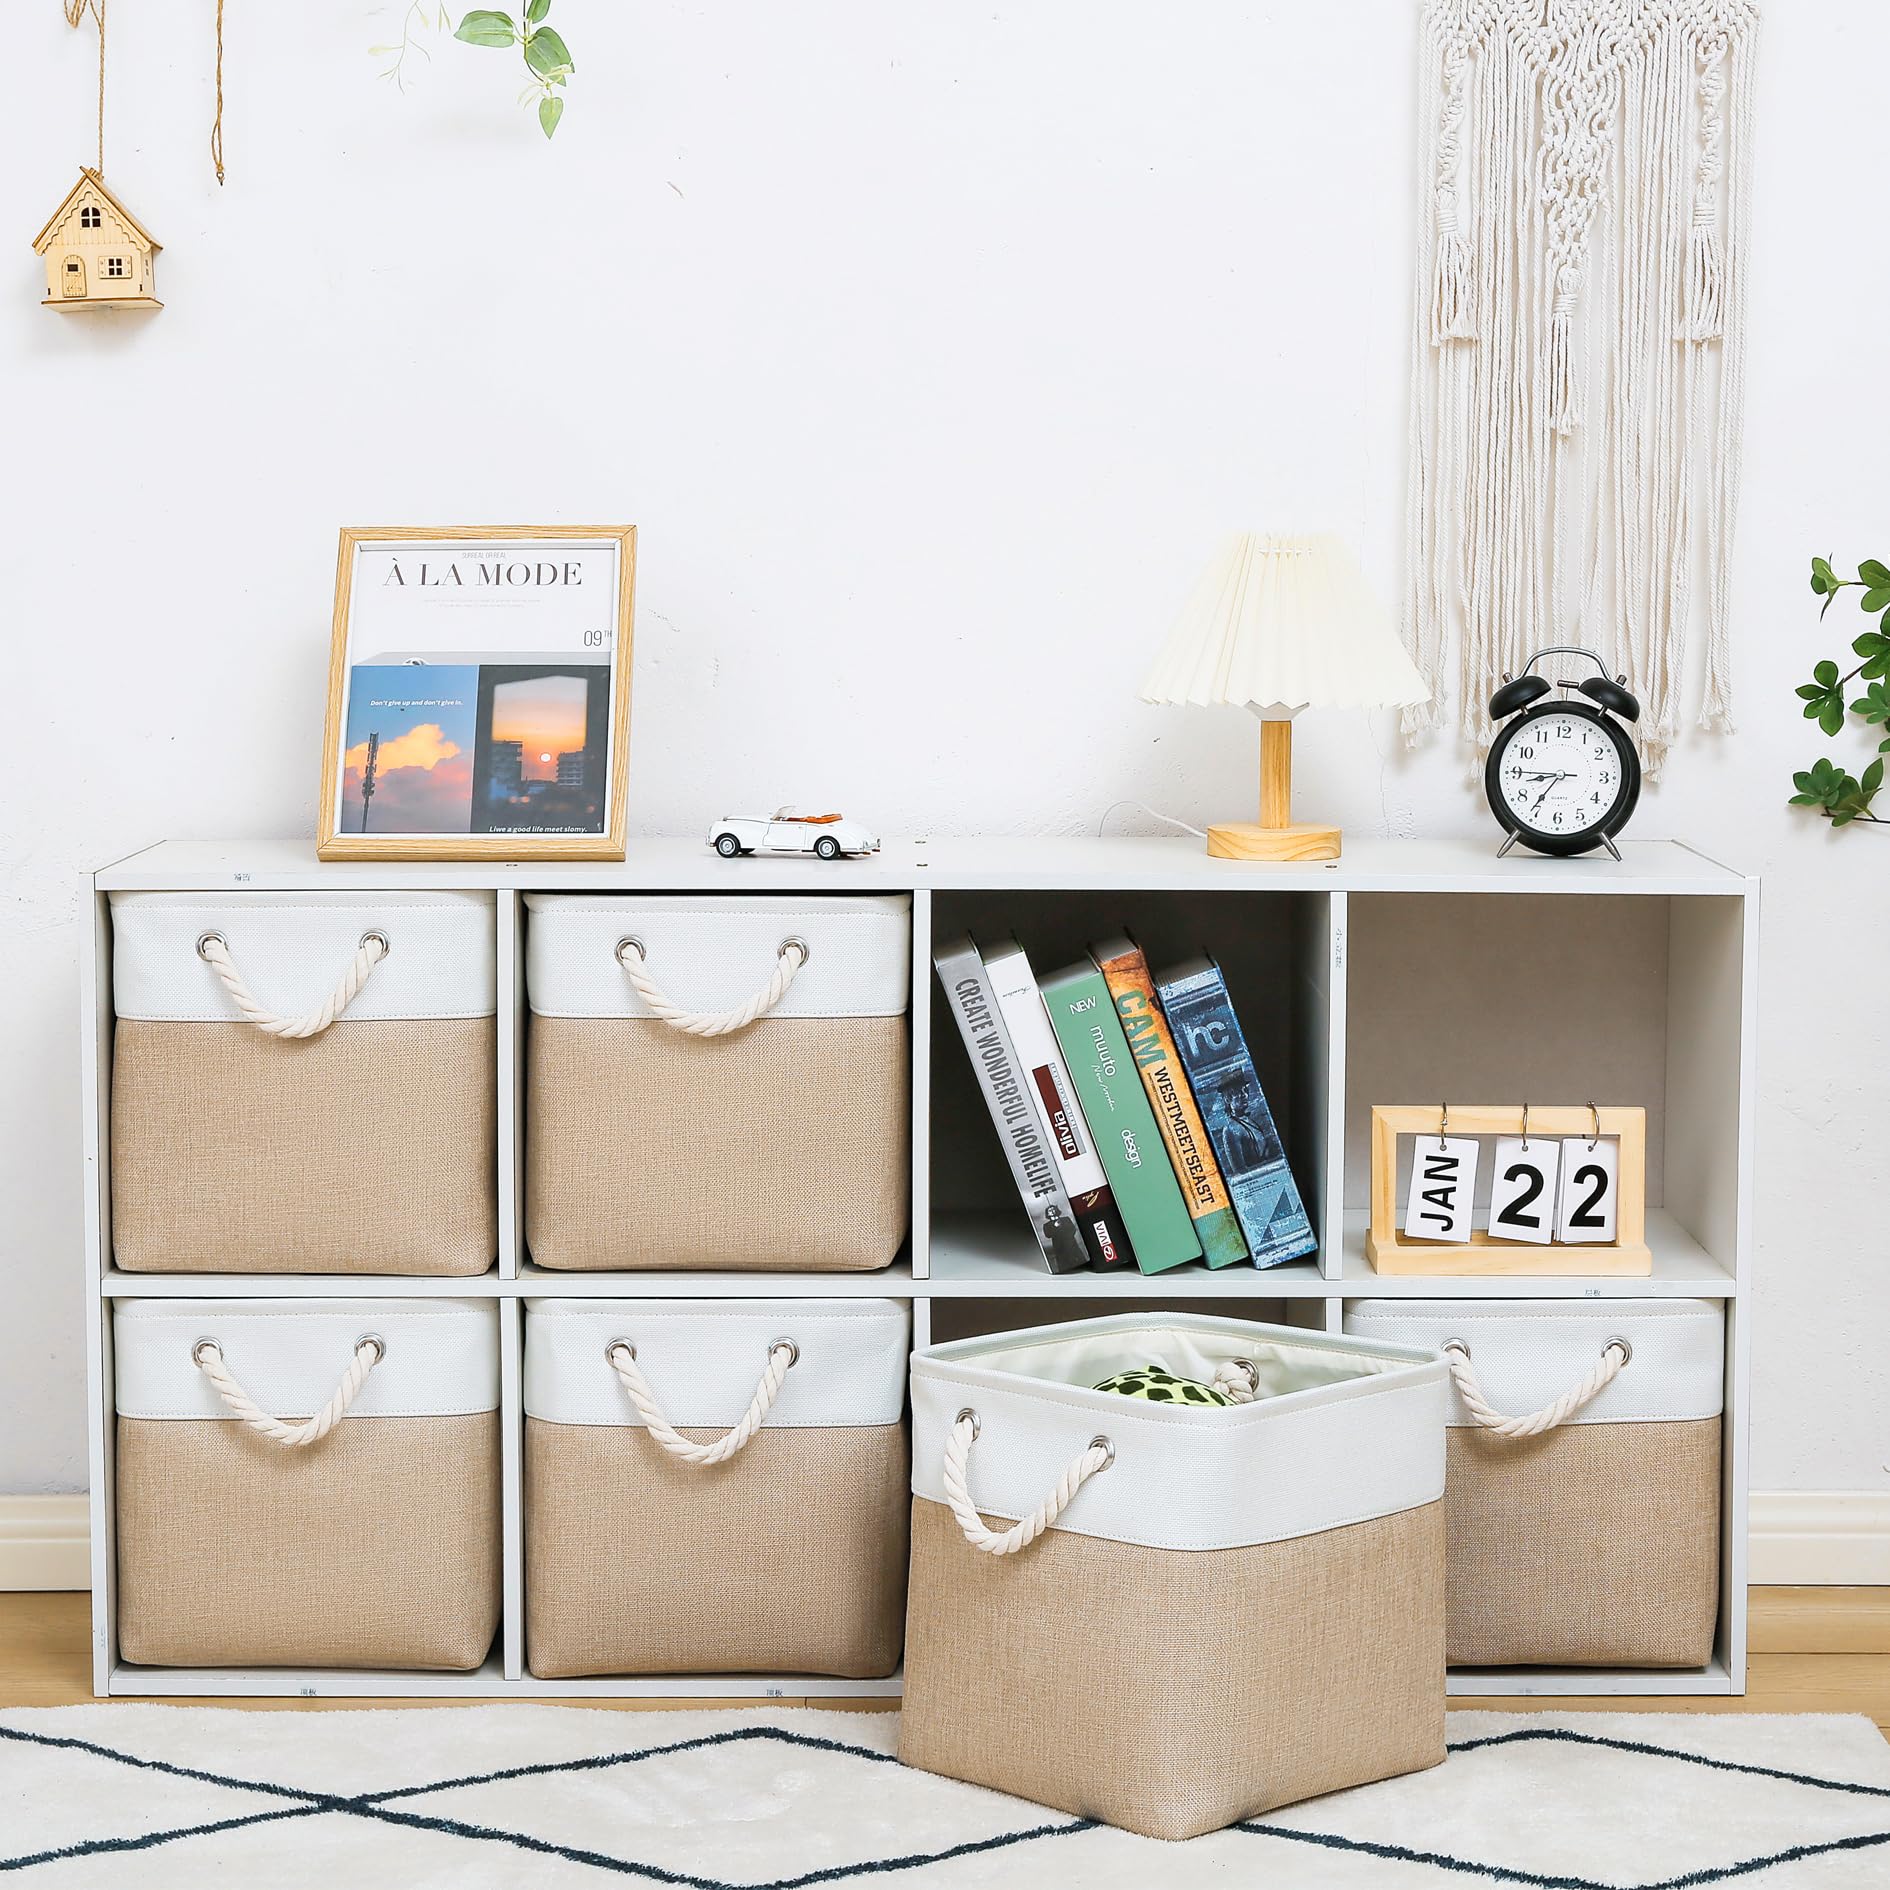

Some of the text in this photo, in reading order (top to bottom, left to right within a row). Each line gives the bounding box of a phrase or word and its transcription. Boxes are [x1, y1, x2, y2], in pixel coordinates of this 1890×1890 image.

[382, 557, 583, 587] À LA MODE
[1535, 730, 1548, 743] 11
[1556, 726, 1572, 739] 12
[1581, 733, 1588, 745] 1
[1519, 746, 1534, 760] 10
[1594, 747, 1604, 760] 2
[1512, 766, 1522, 780] 9
[1599, 771, 1609, 784] 3
[1517, 789, 1528, 802] 8
[1590, 791, 1600, 804] 4
[1552, 811, 1563, 824] 6
[1575, 808, 1585, 821] 5
[512, 826, 531, 834] good
[1069, 995, 1097, 1015] NEW
[1116, 989, 1168, 1069] CAM
[1090, 1025, 1116, 1076] muuto
[955, 978, 1058, 1199] CREATE WONDERFUL HOMELIFE
[1053, 1110, 1077, 1155] olivia
[1154, 1066, 1215, 1204] WESTMEETSEAST
[1121, 1129, 1142, 1169] design
[1420, 1155, 1609, 1232] JAN 2 2
